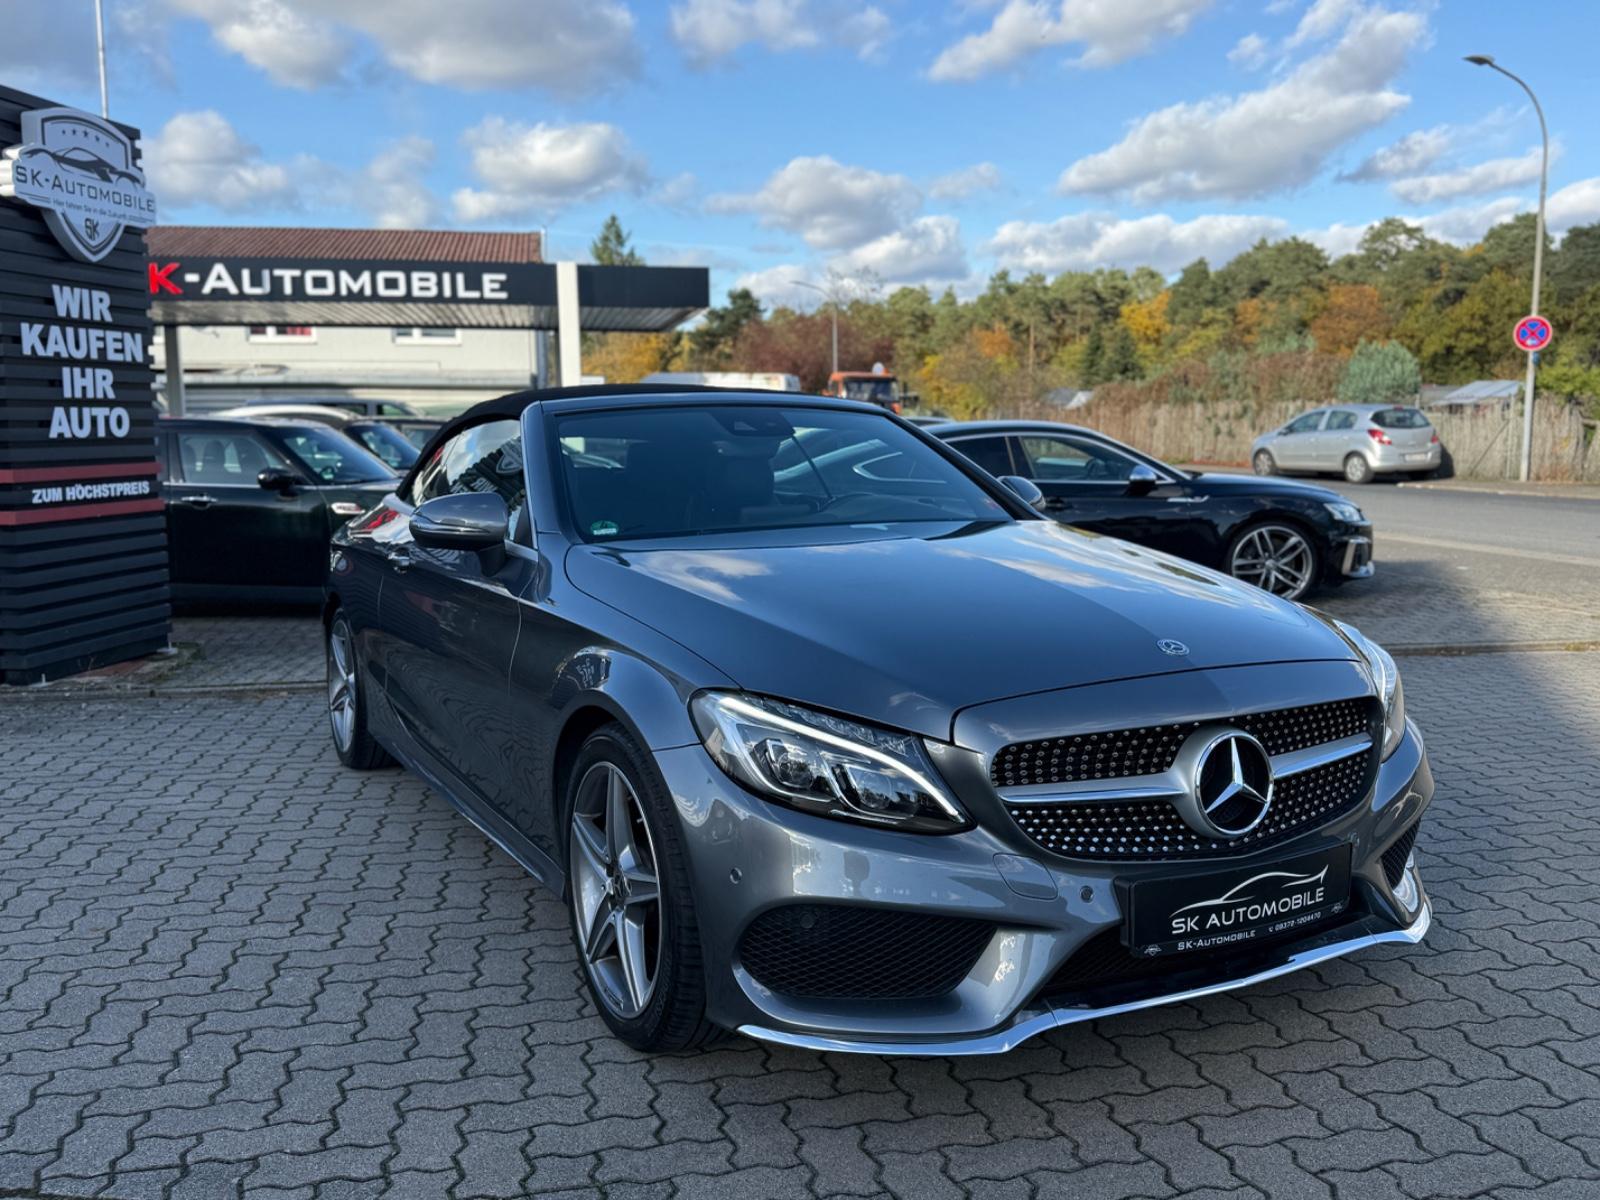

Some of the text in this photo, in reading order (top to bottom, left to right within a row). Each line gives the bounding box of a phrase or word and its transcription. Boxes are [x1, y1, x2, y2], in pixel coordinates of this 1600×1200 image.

[15, 165, 155, 213] SK-AUTOMOBILE
[52, 284, 113, 322] WIR
[20, 322, 144, 363] KAUFEN
[62, 366, 116, 399] IHR
[49, 406, 130, 439] AUTO
[32, 481, 151, 504] ZUM HÖCHSTPREIS
[1172, 887, 1325, 934] SK AUTOMOBILE
[1177, 930, 1256, 951] SK-AUTOMOBILE
